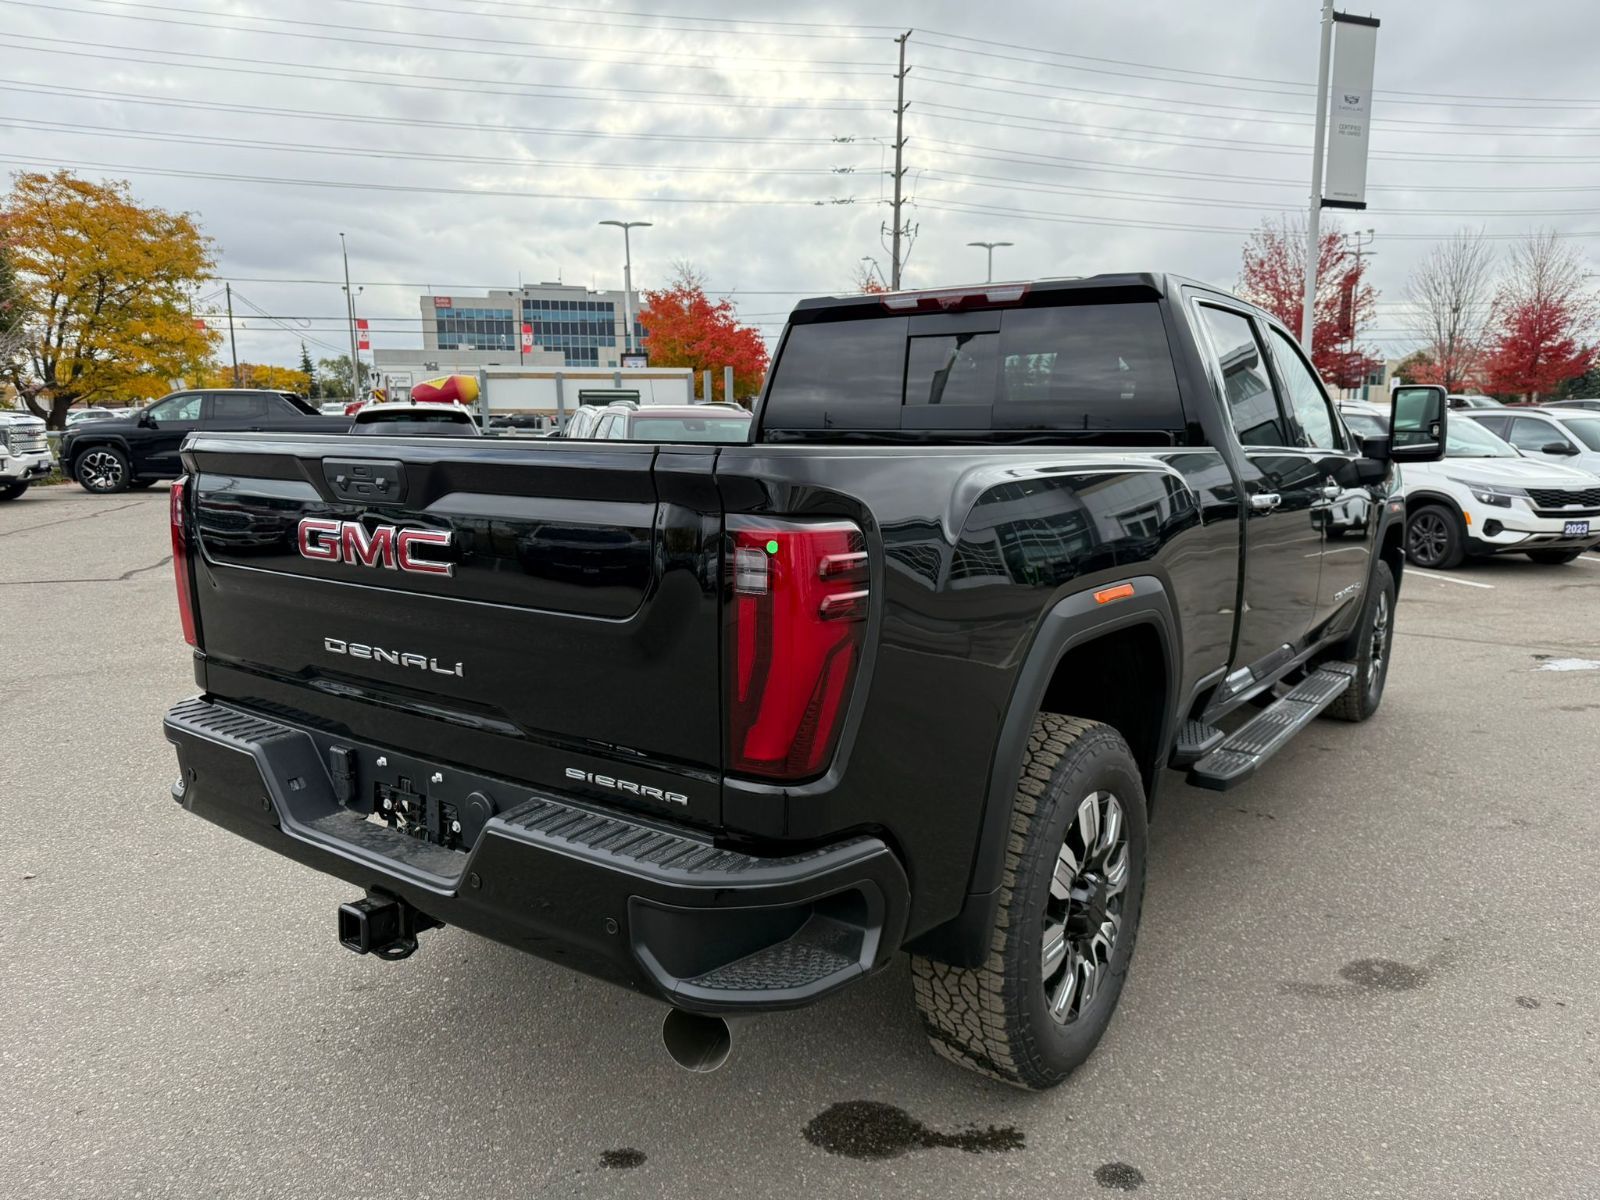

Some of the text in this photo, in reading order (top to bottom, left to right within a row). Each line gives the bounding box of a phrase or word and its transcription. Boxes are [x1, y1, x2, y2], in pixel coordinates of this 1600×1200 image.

[298, 517, 454, 578] GMC
[1565, 524, 1588, 534] 2023
[324, 637, 463, 677] DENALI
[565, 767, 688, 806] SIERRA
